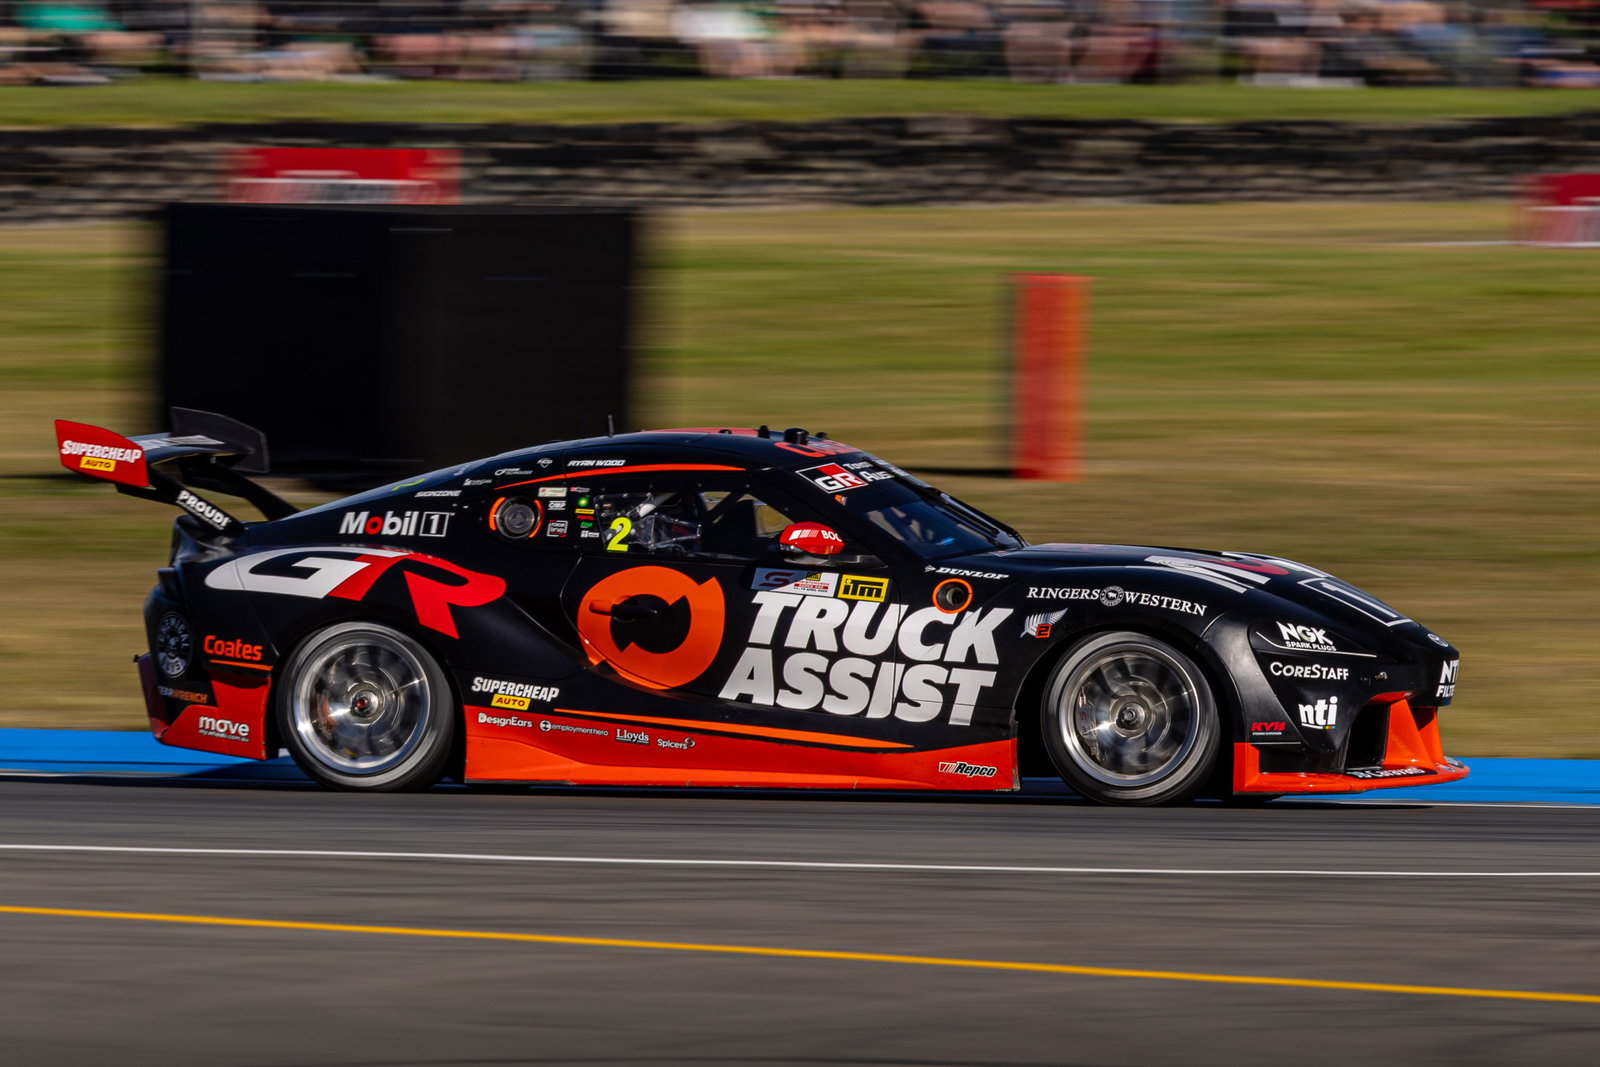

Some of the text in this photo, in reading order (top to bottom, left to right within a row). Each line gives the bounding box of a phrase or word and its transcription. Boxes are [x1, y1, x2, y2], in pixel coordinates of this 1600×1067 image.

[61, 440, 142, 463] SUPERCHEAP
[83, 458, 112, 469] AUTO
[814, 472, 862, 491] GR
[339, 511, 419, 536] Mobil
[607, 517, 632, 552] 2
[936, 567, 1009, 580] DUNLOP
[204, 546, 507, 640] GR
[1027, 586, 1207, 617] RINGERS WESTERN
[748, 590, 1014, 665] TRUCK
[1276, 621, 1333, 645] NGK
[203, 634, 263, 662] Coates
[1285, 641, 1337, 652] SPARK PLUGS
[471, 676, 560, 702] SUPERCHEAP
[718, 647, 998, 726] ASSIST
[495, 697, 526, 707] AUTO
[1299, 696, 1338, 727] nti
[198, 715, 250, 736] move
[477, 712, 533, 728] DesignEars
[1251, 722, 1287, 731] KYB
[616, 728, 649, 742] Lloyds
[657, 738, 689, 750] Spicers
[954, 762, 997, 778] Repco
